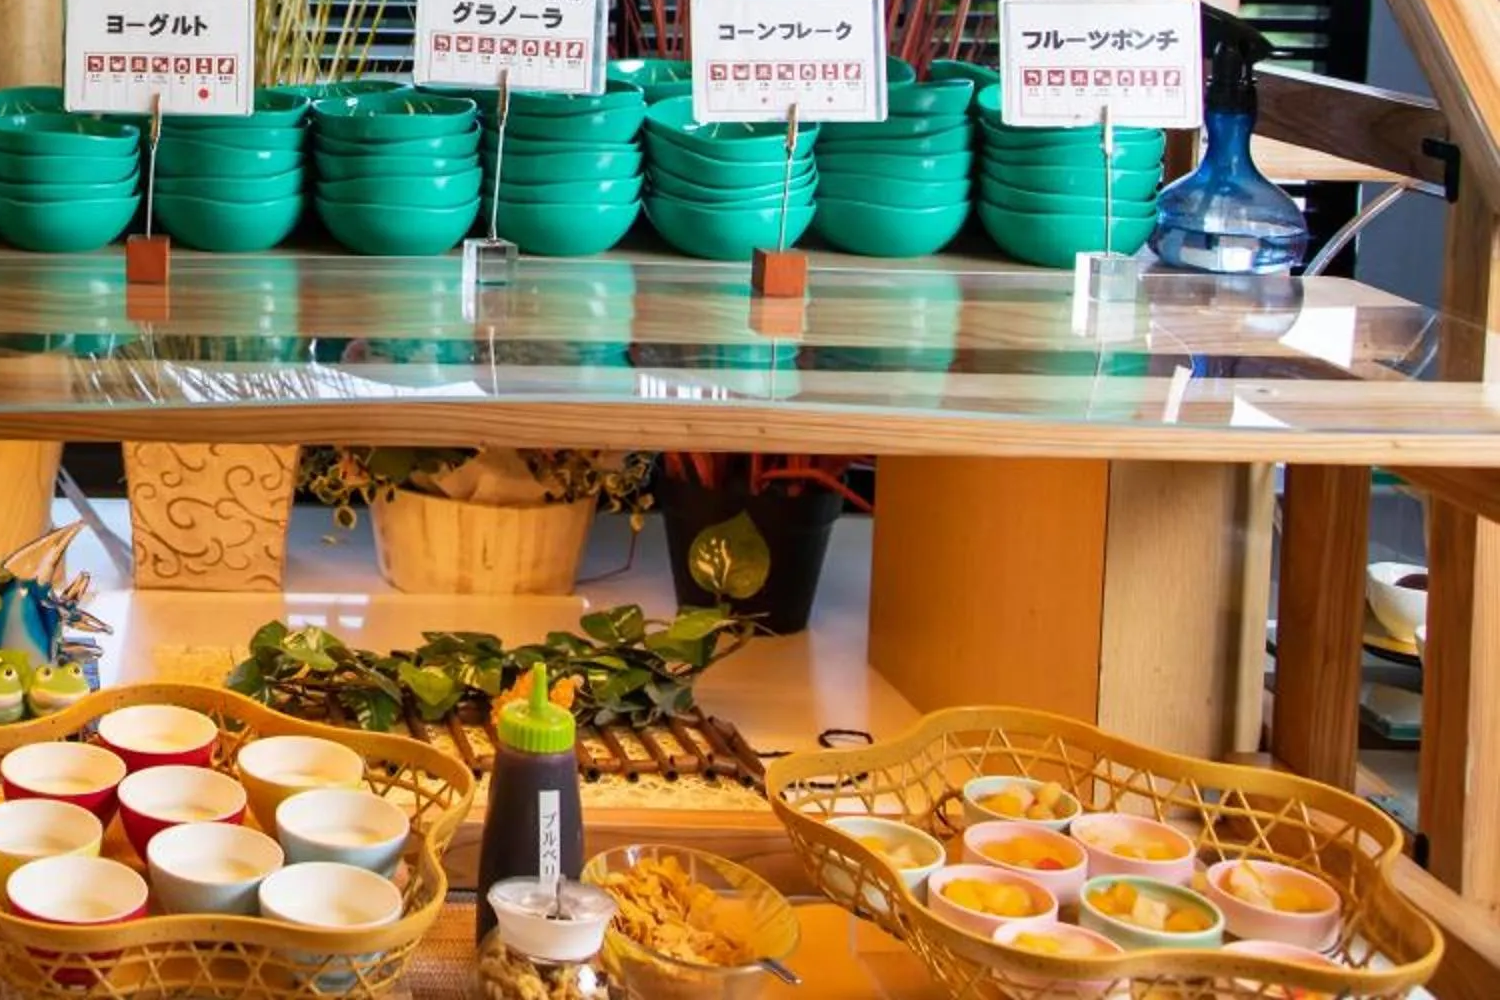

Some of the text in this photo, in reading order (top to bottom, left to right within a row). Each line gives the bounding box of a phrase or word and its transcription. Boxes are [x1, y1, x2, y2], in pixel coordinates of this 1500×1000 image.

[106, 14, 208, 37] ヨーグルト
[452, 0, 563, 29] グラノーラ
[718, 21, 852, 40] コーンフレーク
[1022, 30, 1179, 51] フルーツポンチ
